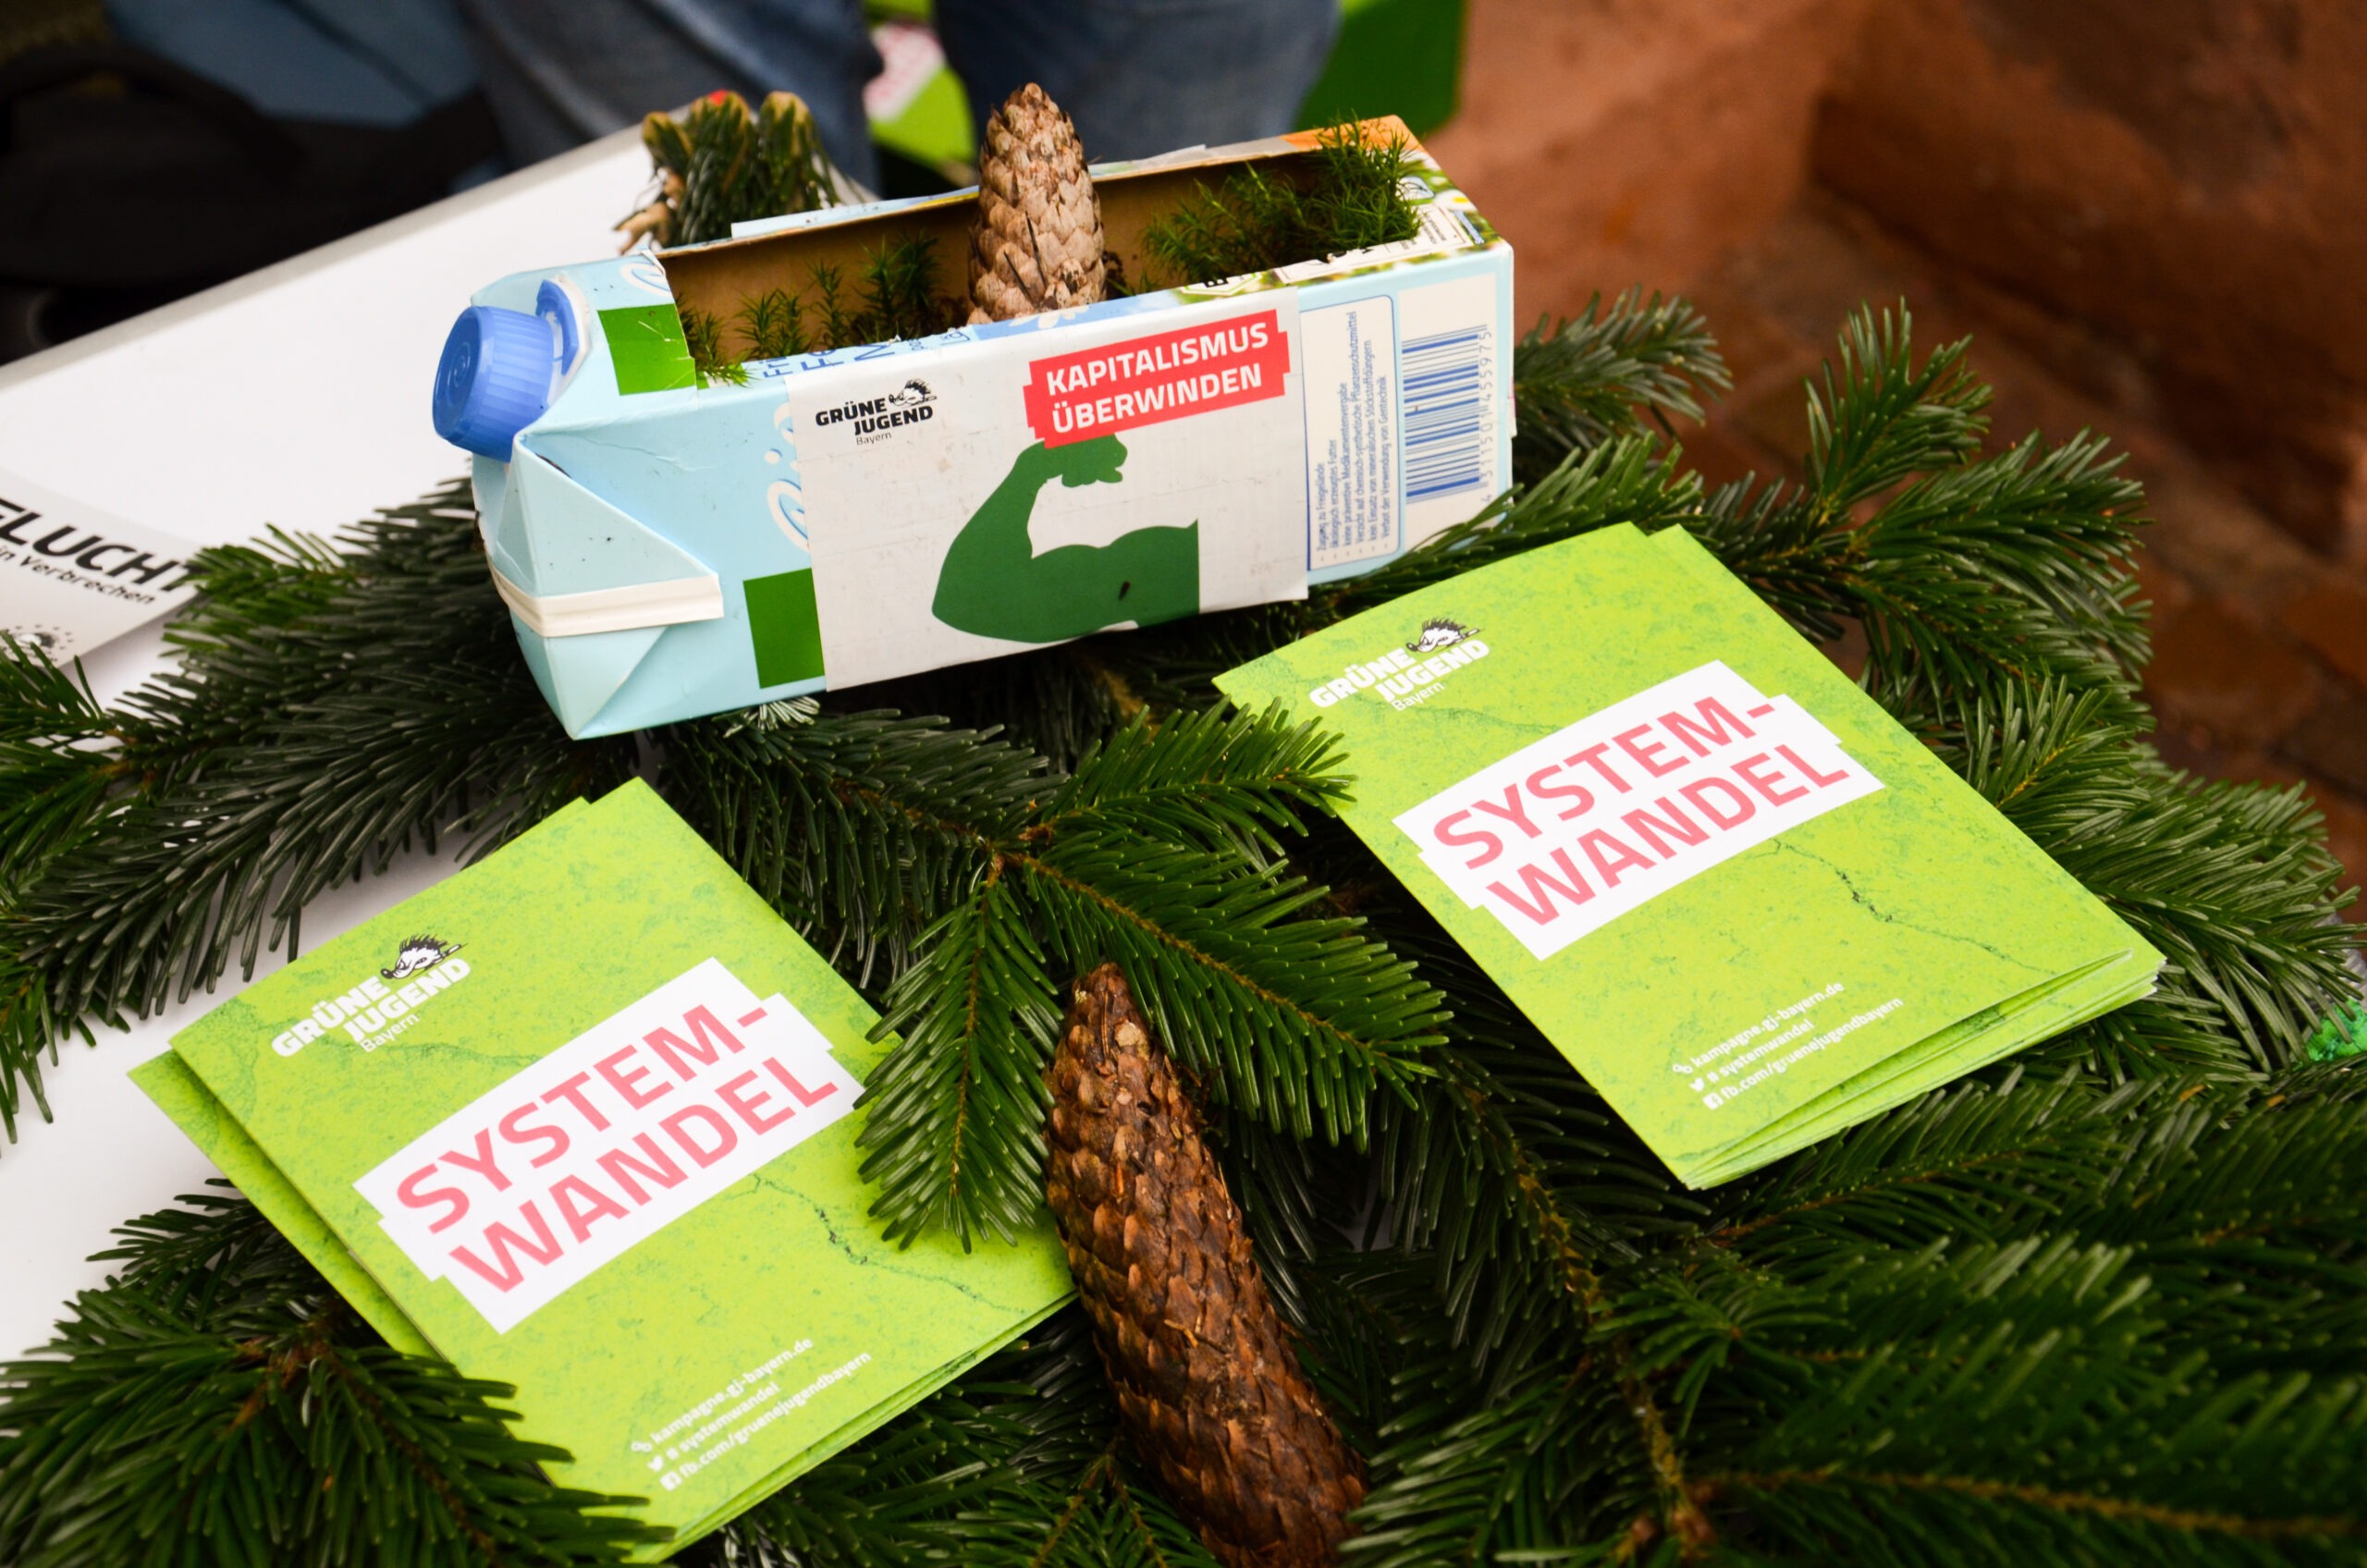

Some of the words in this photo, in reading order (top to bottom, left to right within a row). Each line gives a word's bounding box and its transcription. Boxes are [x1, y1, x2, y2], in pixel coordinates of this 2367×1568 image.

[1047, 322, 1269, 396] KAPITALISMUS
[1346, 311, 1361, 401] Pflanzenschutzmittel
[1363, 339, 1376, 418] Stickstoffdüngern
[815, 398, 887, 426] GRÜNE
[853, 405, 934, 435] JUGEND
[1051, 363, 1262, 434] ÜBERWINDEN
[1377, 374, 1389, 424] Gentechnik
[856, 431, 892, 446] Bayern
[1328, 439, 1337, 465] Futter
[1337, 383, 1351, 480] Medikamentenvergabe
[1353, 404, 1368, 496] chemisch-synthetische
[1366, 419, 1377, 476] mineralischen
[1380, 425, 1389, 441] von
[1330, 465, 1341, 506] erzeugtes
[1380, 443, 1392, 496] Verwendung
[1331, 507, 1343, 548] ökologisch
[1343, 482, 1355, 524] präventive
[1355, 498, 1365, 510] auf
[1355, 512, 1366, 545] Verzicht
[1367, 496, 1378, 523] Einsatz
[1380, 512, 1391, 540] Verbot
[1381, 497, 1390, 510] der
[1343, 526, 1352, 547] keine
[1368, 524, 1378, 541] kein
[19, 555, 155, 604] Verbrechen
[1308, 647, 1417, 708] GRÜNE
[1374, 639, 1490, 703] JUGEND
[1392, 680, 1446, 712] Bayern
[1433, 696, 1776, 870] SYSTEM-
[1485, 743, 1851, 926] WANDEL
[271, 975, 391, 1057] GRÜNE
[342, 958, 471, 1043] JUGEND
[1690, 982, 1845, 1068] kampagne.gj-bayern.de
[360, 1013, 421, 1053] Bayern
[1719, 1019, 1815, 1077] systemwandel
[1720, 998, 1905, 1100] fb.com/gruenejugendbayern
[396, 1004, 768, 1234] SYSTEM-
[448, 1056, 839, 1293] WANDEL
[650, 1339, 814, 1444] kampagne.gj-bayern.de
[679, 1352, 872, 1477] fb.com/gruenejugendbayern
[679, 1381, 781, 1452] systemwandel
